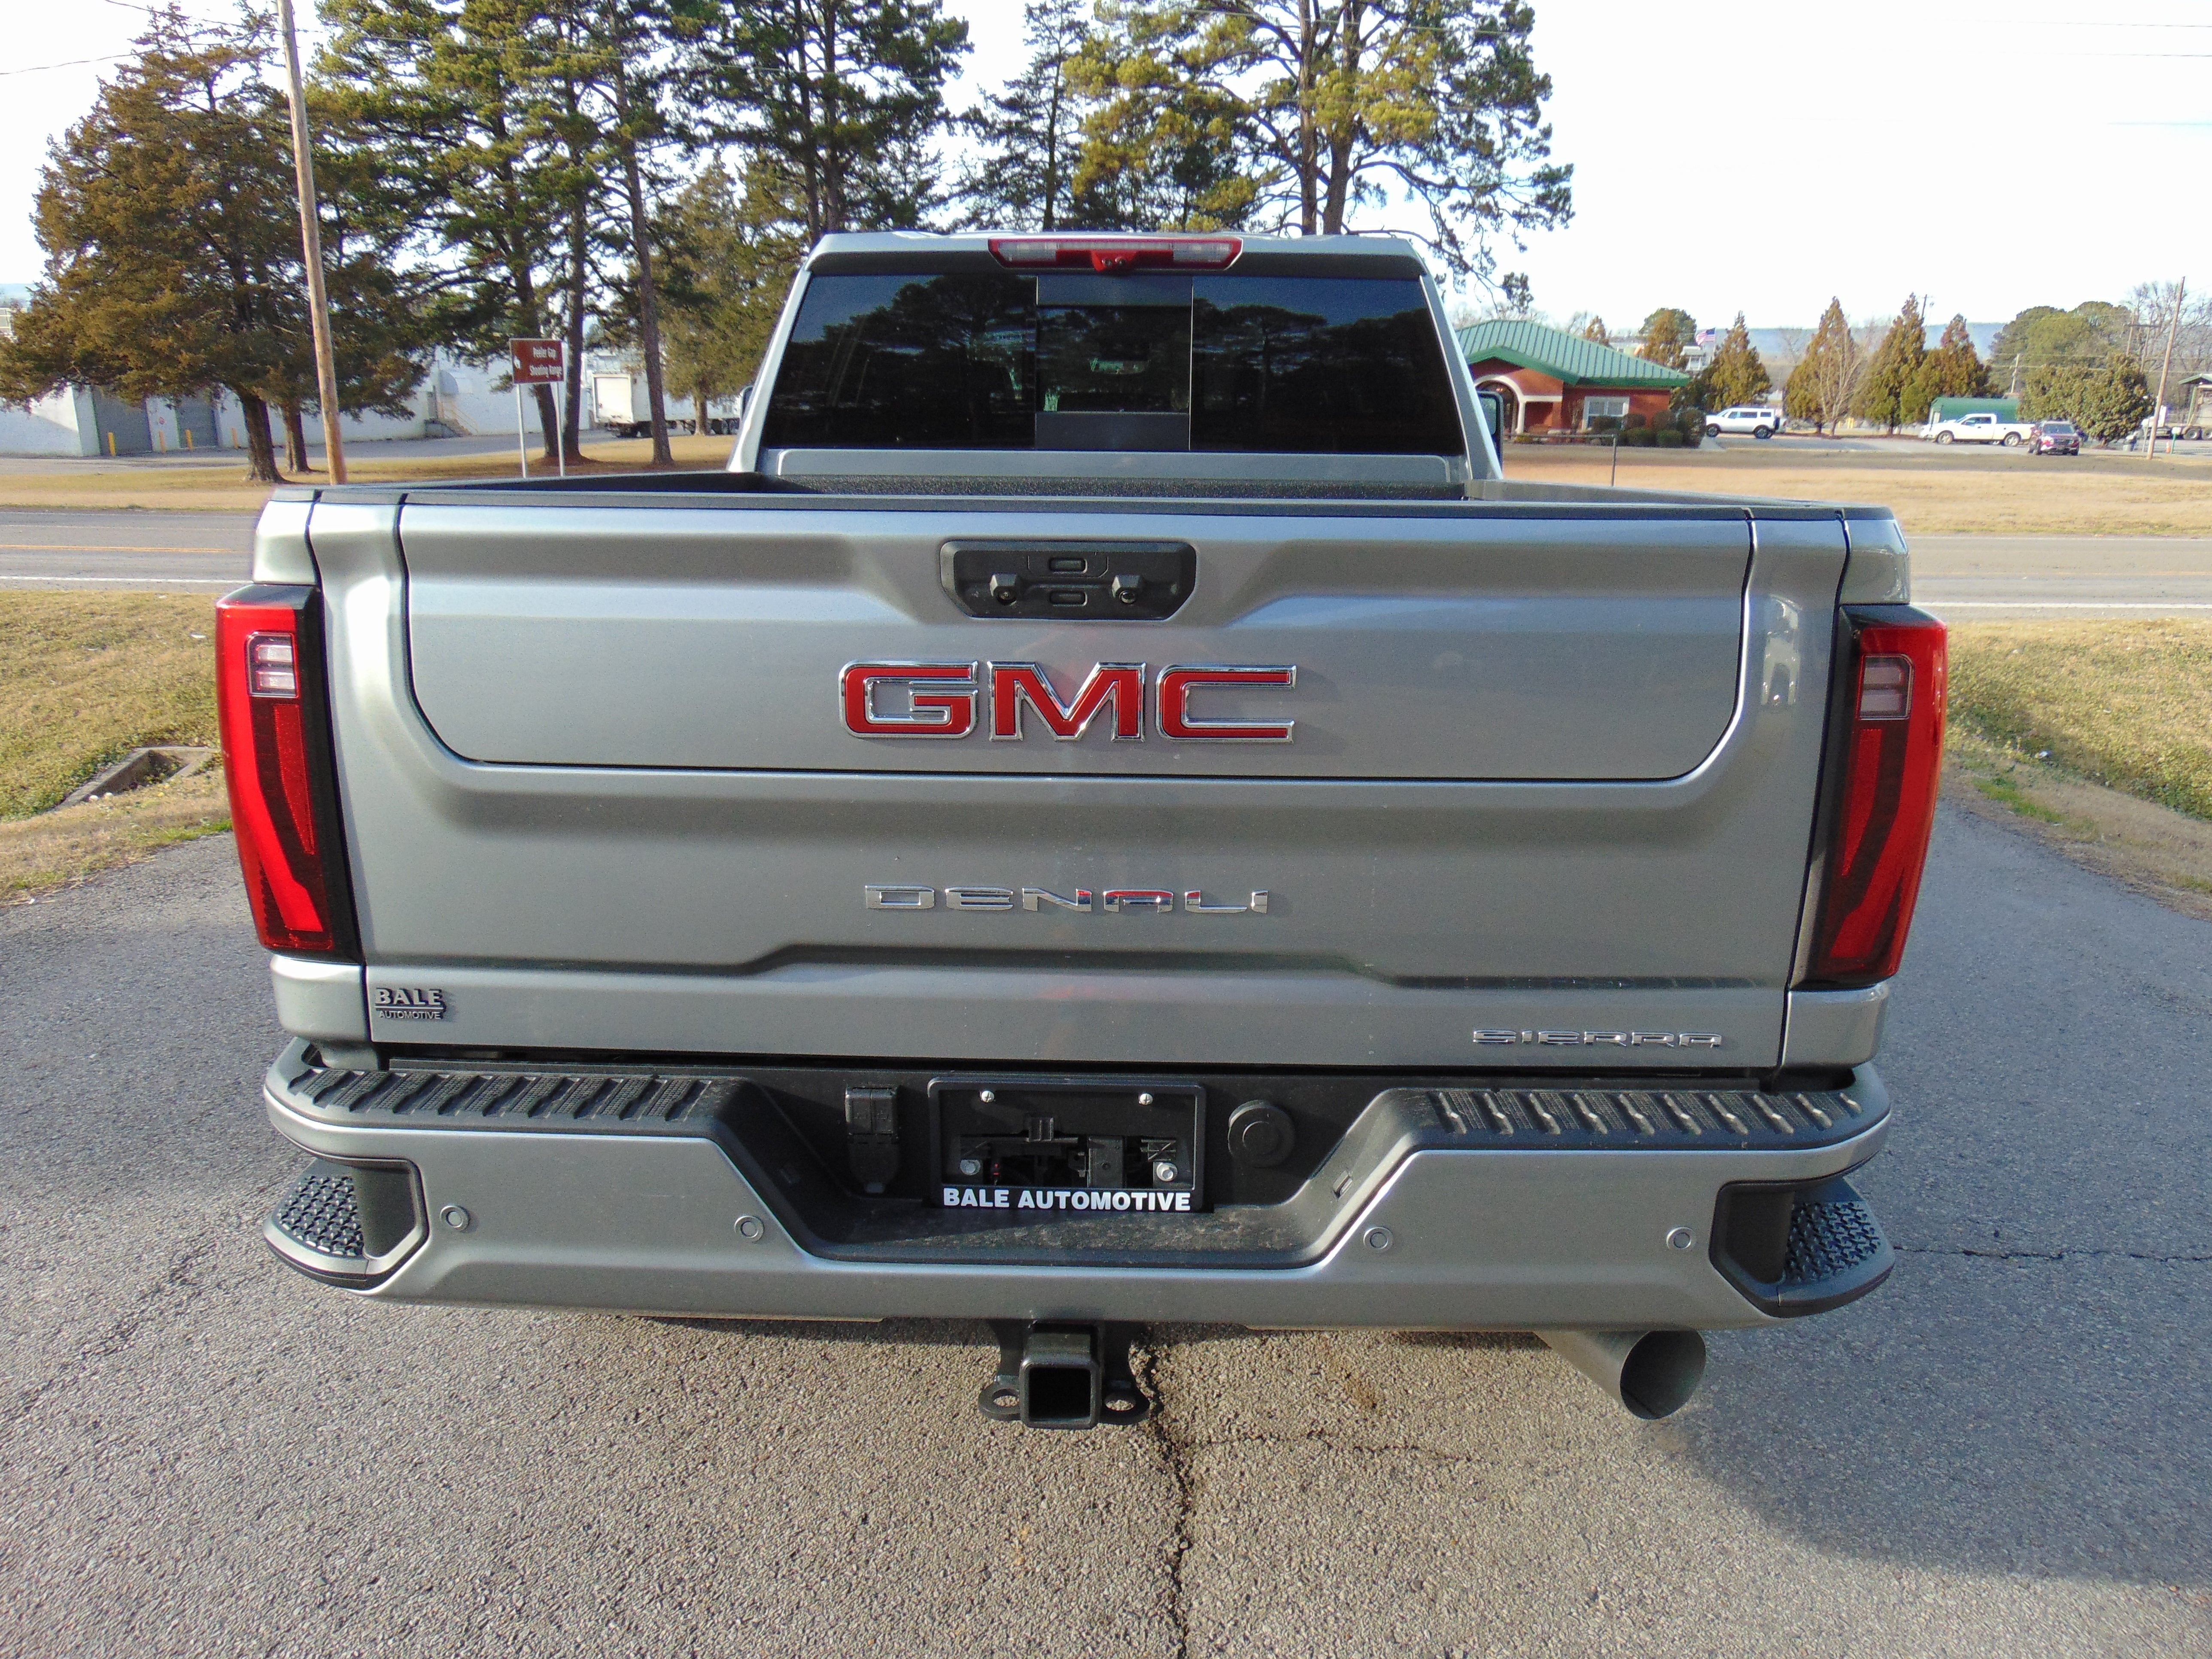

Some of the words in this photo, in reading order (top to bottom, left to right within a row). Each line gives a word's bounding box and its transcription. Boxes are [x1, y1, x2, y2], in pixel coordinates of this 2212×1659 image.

[529, 364, 549, 378] Shooting
[549, 364, 562, 377] Range
[839, 660, 1297, 743] GMC
[865, 884, 1269, 914] DENALI
[375, 988, 442, 1005] BALE
[379, 1010, 441, 1019] AUTOMOTIVE
[1473, 1030, 1722, 1047] SIERRA
[943, 1188, 1009, 1208] BALE
[1018, 1190, 1191, 1210] AUTOMOTIVE
